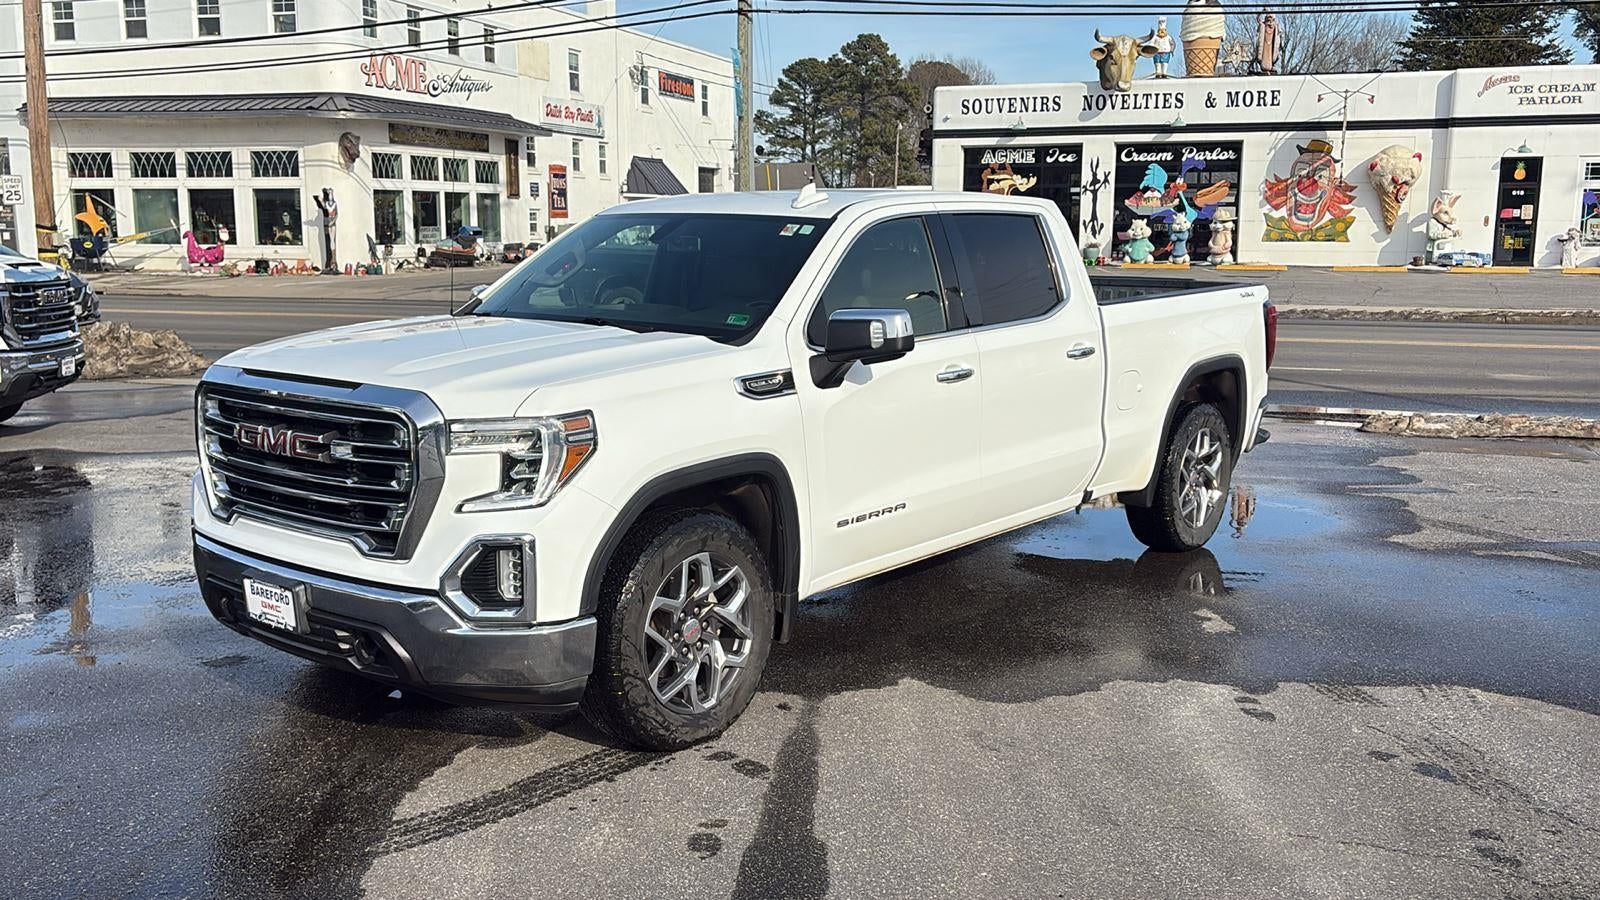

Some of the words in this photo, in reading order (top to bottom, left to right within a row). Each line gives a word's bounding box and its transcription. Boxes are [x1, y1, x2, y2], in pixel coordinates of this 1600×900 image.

[361, 52, 428, 95] ACME
[428, 73, 445, 97] &
[441, 68, 493, 101] Antiques
[658, 72, 694, 97] Firestone
[1508, 85, 1533, 94] ICE
[1538, 83, 1597, 93] CREAM
[961, 95, 1062, 115] SOUVENIRS
[1082, 92, 1184, 112] NOVELTIES
[1205, 91, 1217, 109] &
[1225, 89, 1281, 108] MORE
[1518, 95, 1583, 105] PARLOR
[545, 103, 562, 118] Dutch
[564, 106, 576, 123] Boy
[576, 107, 594, 123] Paints
[981, 149, 1036, 164] ACME
[1045, 148, 1079, 163] Ice
[1120, 147, 1174, 162] Cream
[1181, 147, 1238, 161] Parlor
[5, 190, 22, 201] 25
[553, 194, 566, 208] TEA
[236, 422, 326, 461] GMC
[836, 502, 907, 528] SIERRA
[250, 584, 290, 606] BAREFORD
[260, 600, 282, 614] GMC
